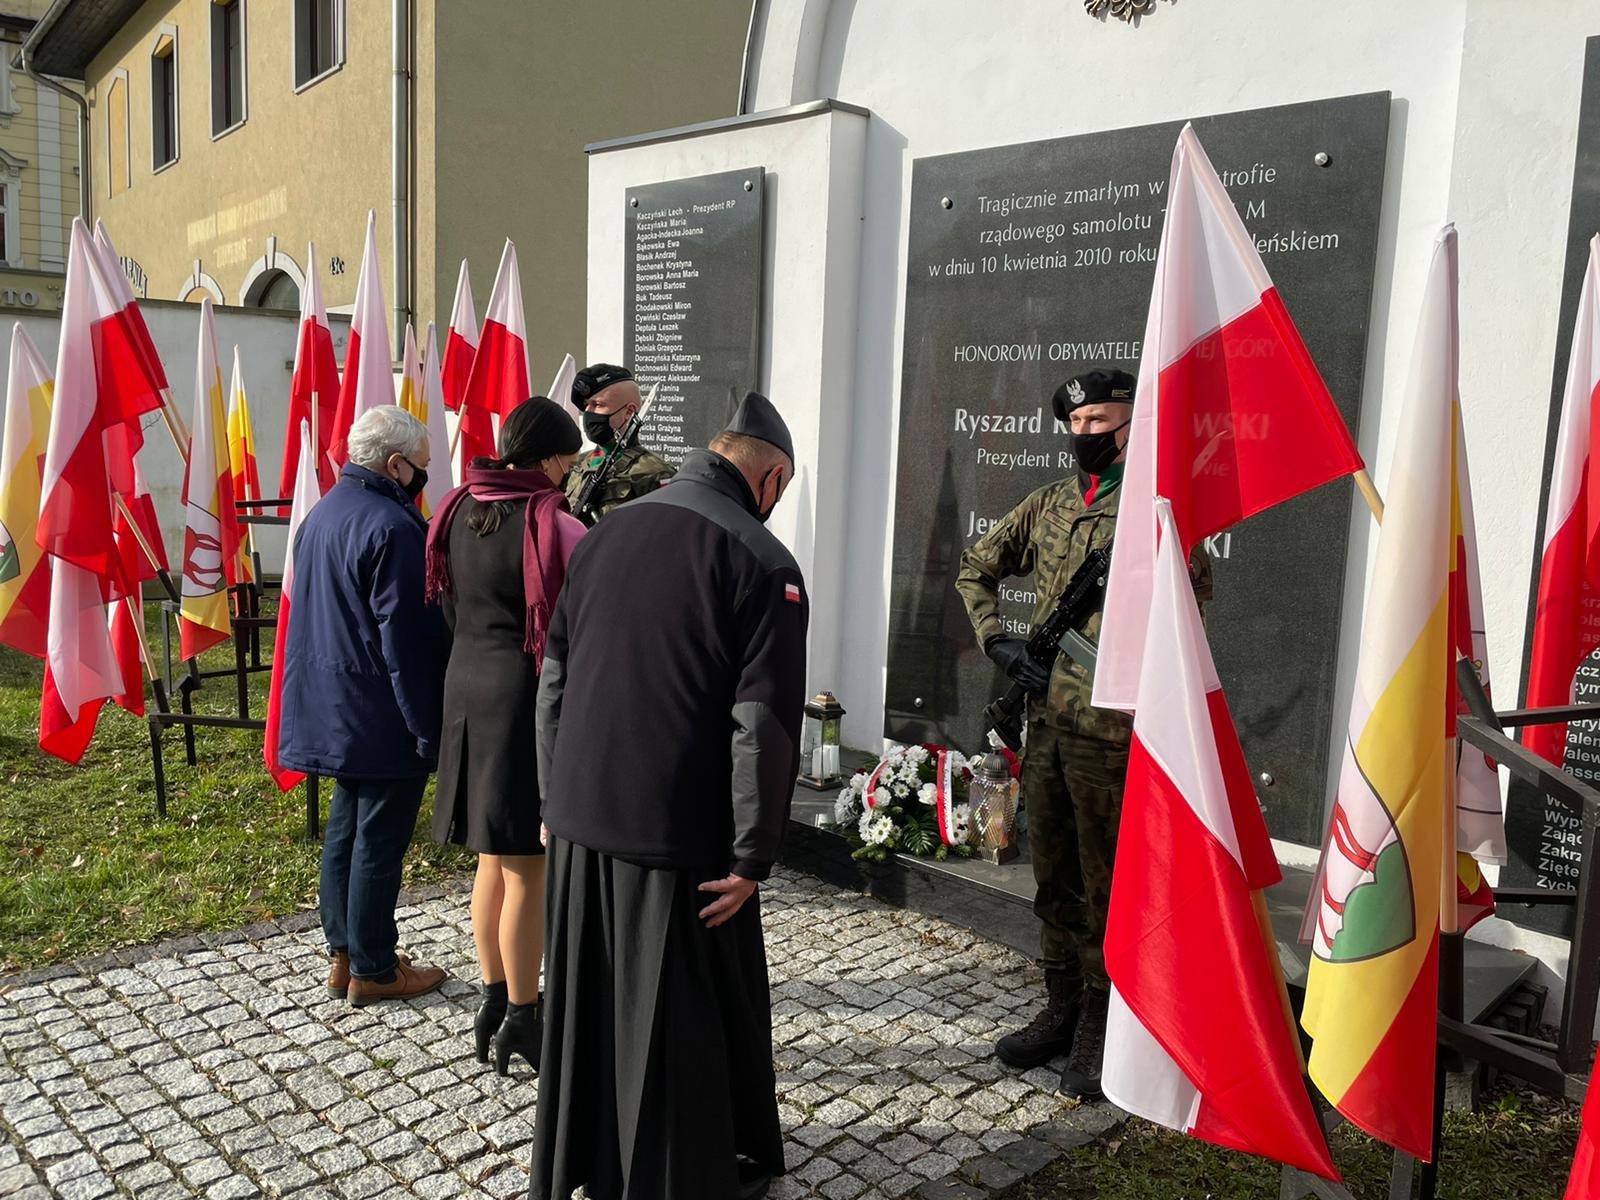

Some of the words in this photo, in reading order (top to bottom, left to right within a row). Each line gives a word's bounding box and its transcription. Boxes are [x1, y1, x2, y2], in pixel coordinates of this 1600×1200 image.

[978, 189, 1057, 217] Tragicznie
[1064, 181, 1140, 206] zmarłym
[1148, 180, 1164, 195] w
[668, 207, 683, 217] Lech
[692, 202, 725, 214] Prezydent
[726, 199, 736, 209] RP
[670, 218, 686, 227] Maria
[980, 222, 1065, 246] rządowego
[1072, 211, 1152, 236] samolotu
[1245, 199, 1266, 220] M
[682, 227, 703, 236] Joanna
[667, 239, 680, 248] Ewa
[655, 250, 677, 260] Andrzej
[928, 264, 941, 277] w
[945, 258, 975, 277] dniu
[981, 256, 997, 274] 10
[1003, 253, 1068, 273] kwietnia
[1073, 246, 1112, 268] 2010
[1119, 242, 1157, 264] roku
[1251, 230, 1340, 254] leńskiem
[666, 260, 692, 271] Krystyna
[636, 273, 664, 282] Borowska
[666, 271, 681, 279] Anna
[683, 269, 699, 278] Maria
[636, 282, 662, 291] Borowski
[664, 281, 686, 290] Bartosz
[649, 292, 672, 301] Tadeusz
[635, 302, 673, 311] Chodakowski
[674, 301, 692, 310] Miron
[659, 322, 679, 331] Leszek
[656, 332, 683, 343] Zbigniew
[656, 343, 683, 353] Grzegorz
[954, 344, 1041, 362] HONOROWI
[1049, 341, 1140, 361] OBYWATELE
[671, 353, 701, 363] Katarzyna
[635, 363, 669, 372] Duchnowski
[670, 363, 693, 372] Edward
[635, 373, 667, 382] Fedorowicz
[667, 373, 701, 382] Aleksander
[660, 383, 680, 392] Janina
[658, 403, 673, 412] Artur
[652, 413, 684, 423] Franciszek
[954, 407, 1043, 440] Ryszard
[655, 433, 684, 443] Kazimierz
[977, 448, 1050, 471] Prezydent
